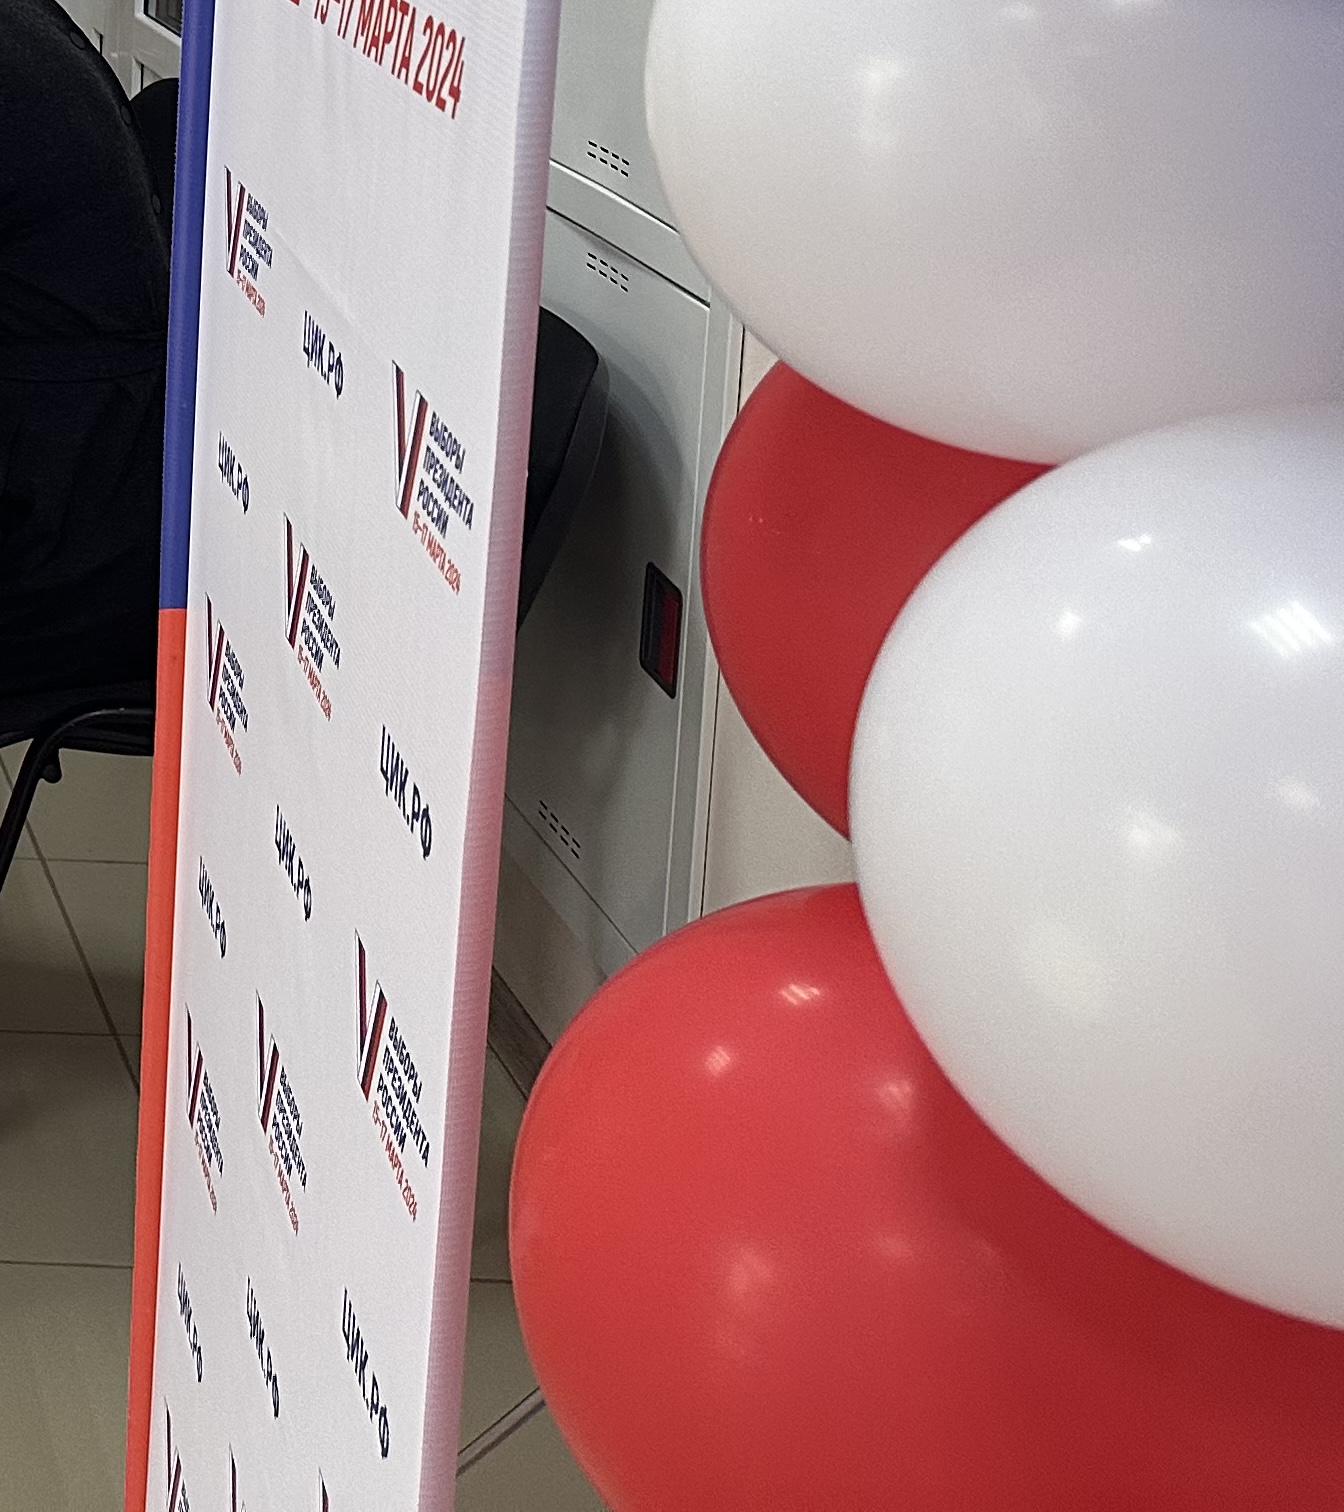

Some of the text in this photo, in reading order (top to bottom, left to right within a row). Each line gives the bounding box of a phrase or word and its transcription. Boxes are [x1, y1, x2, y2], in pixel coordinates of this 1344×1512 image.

[412, 15, 466, 120] 2024
[303, 310, 343, 400] ЦИК.РФ
[218, 431, 249, 515] ЦИК.РФ
[423, 444, 474, 530] ПРЕЗИДЕНТА
[429, 410, 465, 474] ВЫБОРЫ
[417, 478, 449, 539] РОССИИ
[379, 724, 432, 860] ЦИК.РФ
[199, 855, 227, 958] ЦИК.РФ
[275, 804, 312, 921] ЦИК.РФ
[382, 1044, 430, 1168] ПРЕЗИДЕНТА
[389, 1016, 422, 1104] ВЫБОРЫ
[376, 1072, 407, 1154] РОССИИ
[177, 1262, 203, 1382] ЦИК.РФ
[247, 1275, 279, 1419] ЦИК.РФ
[342, 1286, 390, 1459] ЦИК.РФ
